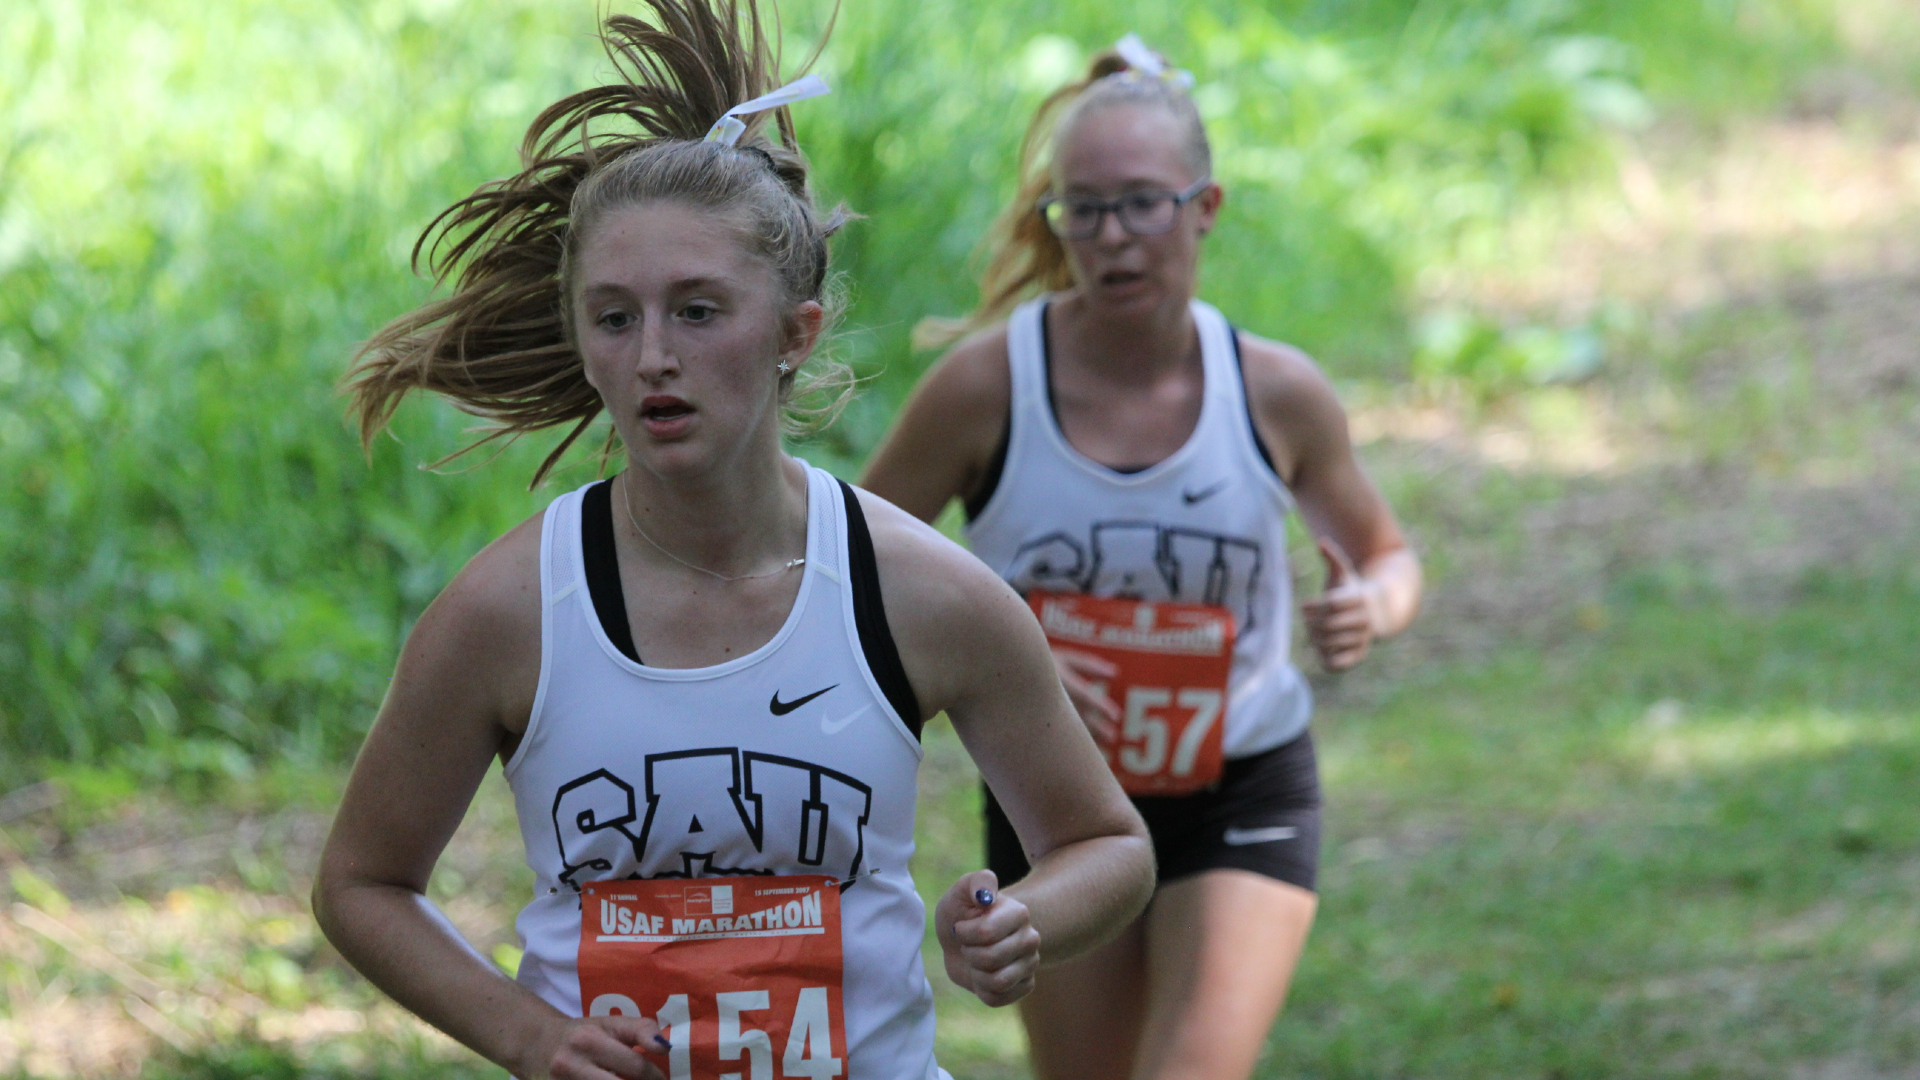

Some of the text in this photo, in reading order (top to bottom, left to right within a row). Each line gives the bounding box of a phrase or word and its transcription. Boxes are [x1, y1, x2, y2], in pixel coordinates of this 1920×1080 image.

[1100, 684, 1223, 778] 57
[552, 746, 872, 897] SAU
[600, 890, 822, 935] USAF MARATHON
